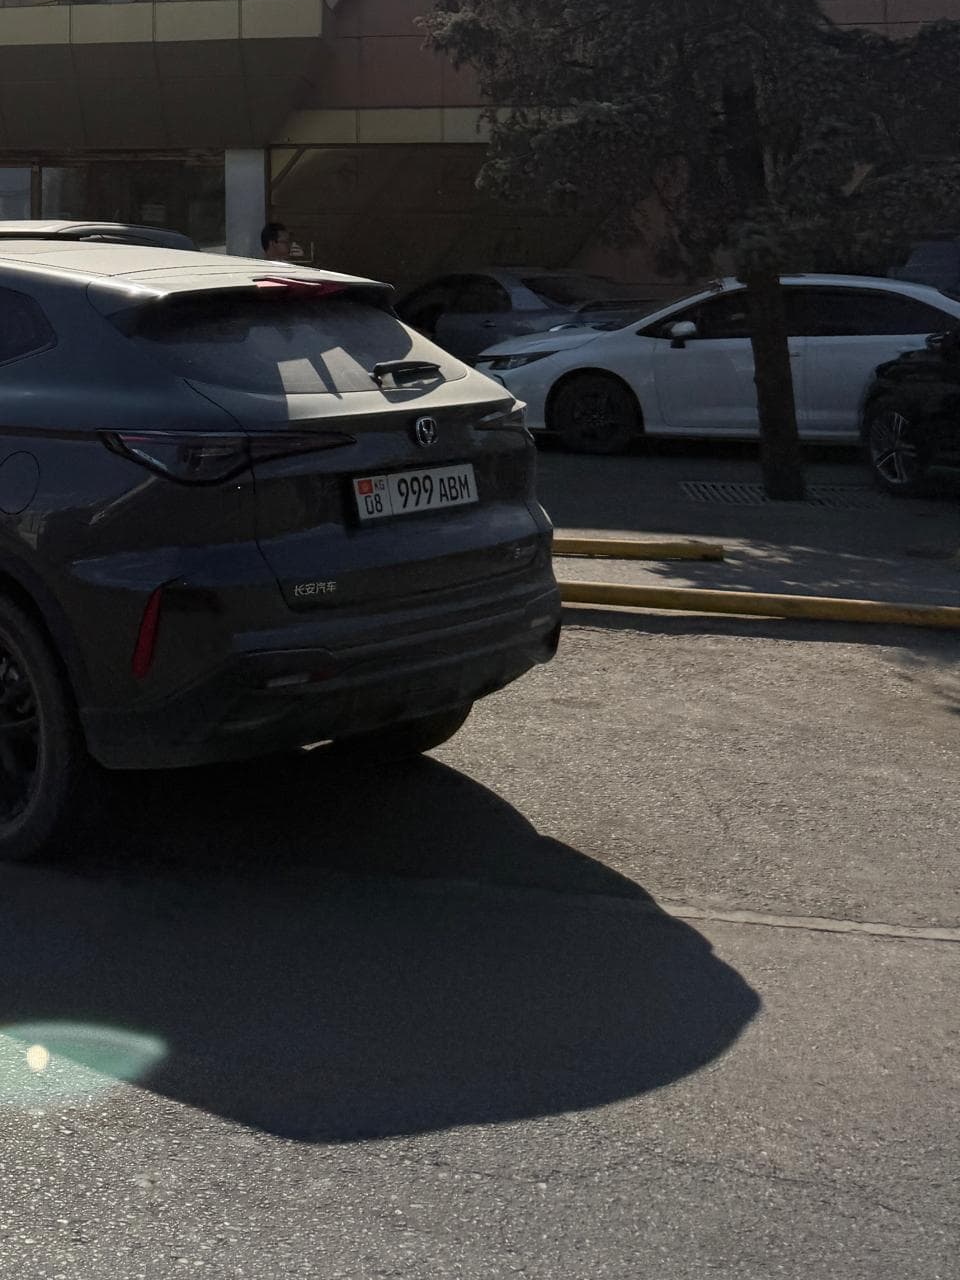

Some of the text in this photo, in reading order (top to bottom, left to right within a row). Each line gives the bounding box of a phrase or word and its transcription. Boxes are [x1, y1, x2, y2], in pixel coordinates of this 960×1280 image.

[397, 474, 471, 509] 999 ABM
[364, 493, 383, 515] 08
[294, 581, 337, 597] 长安汽车
